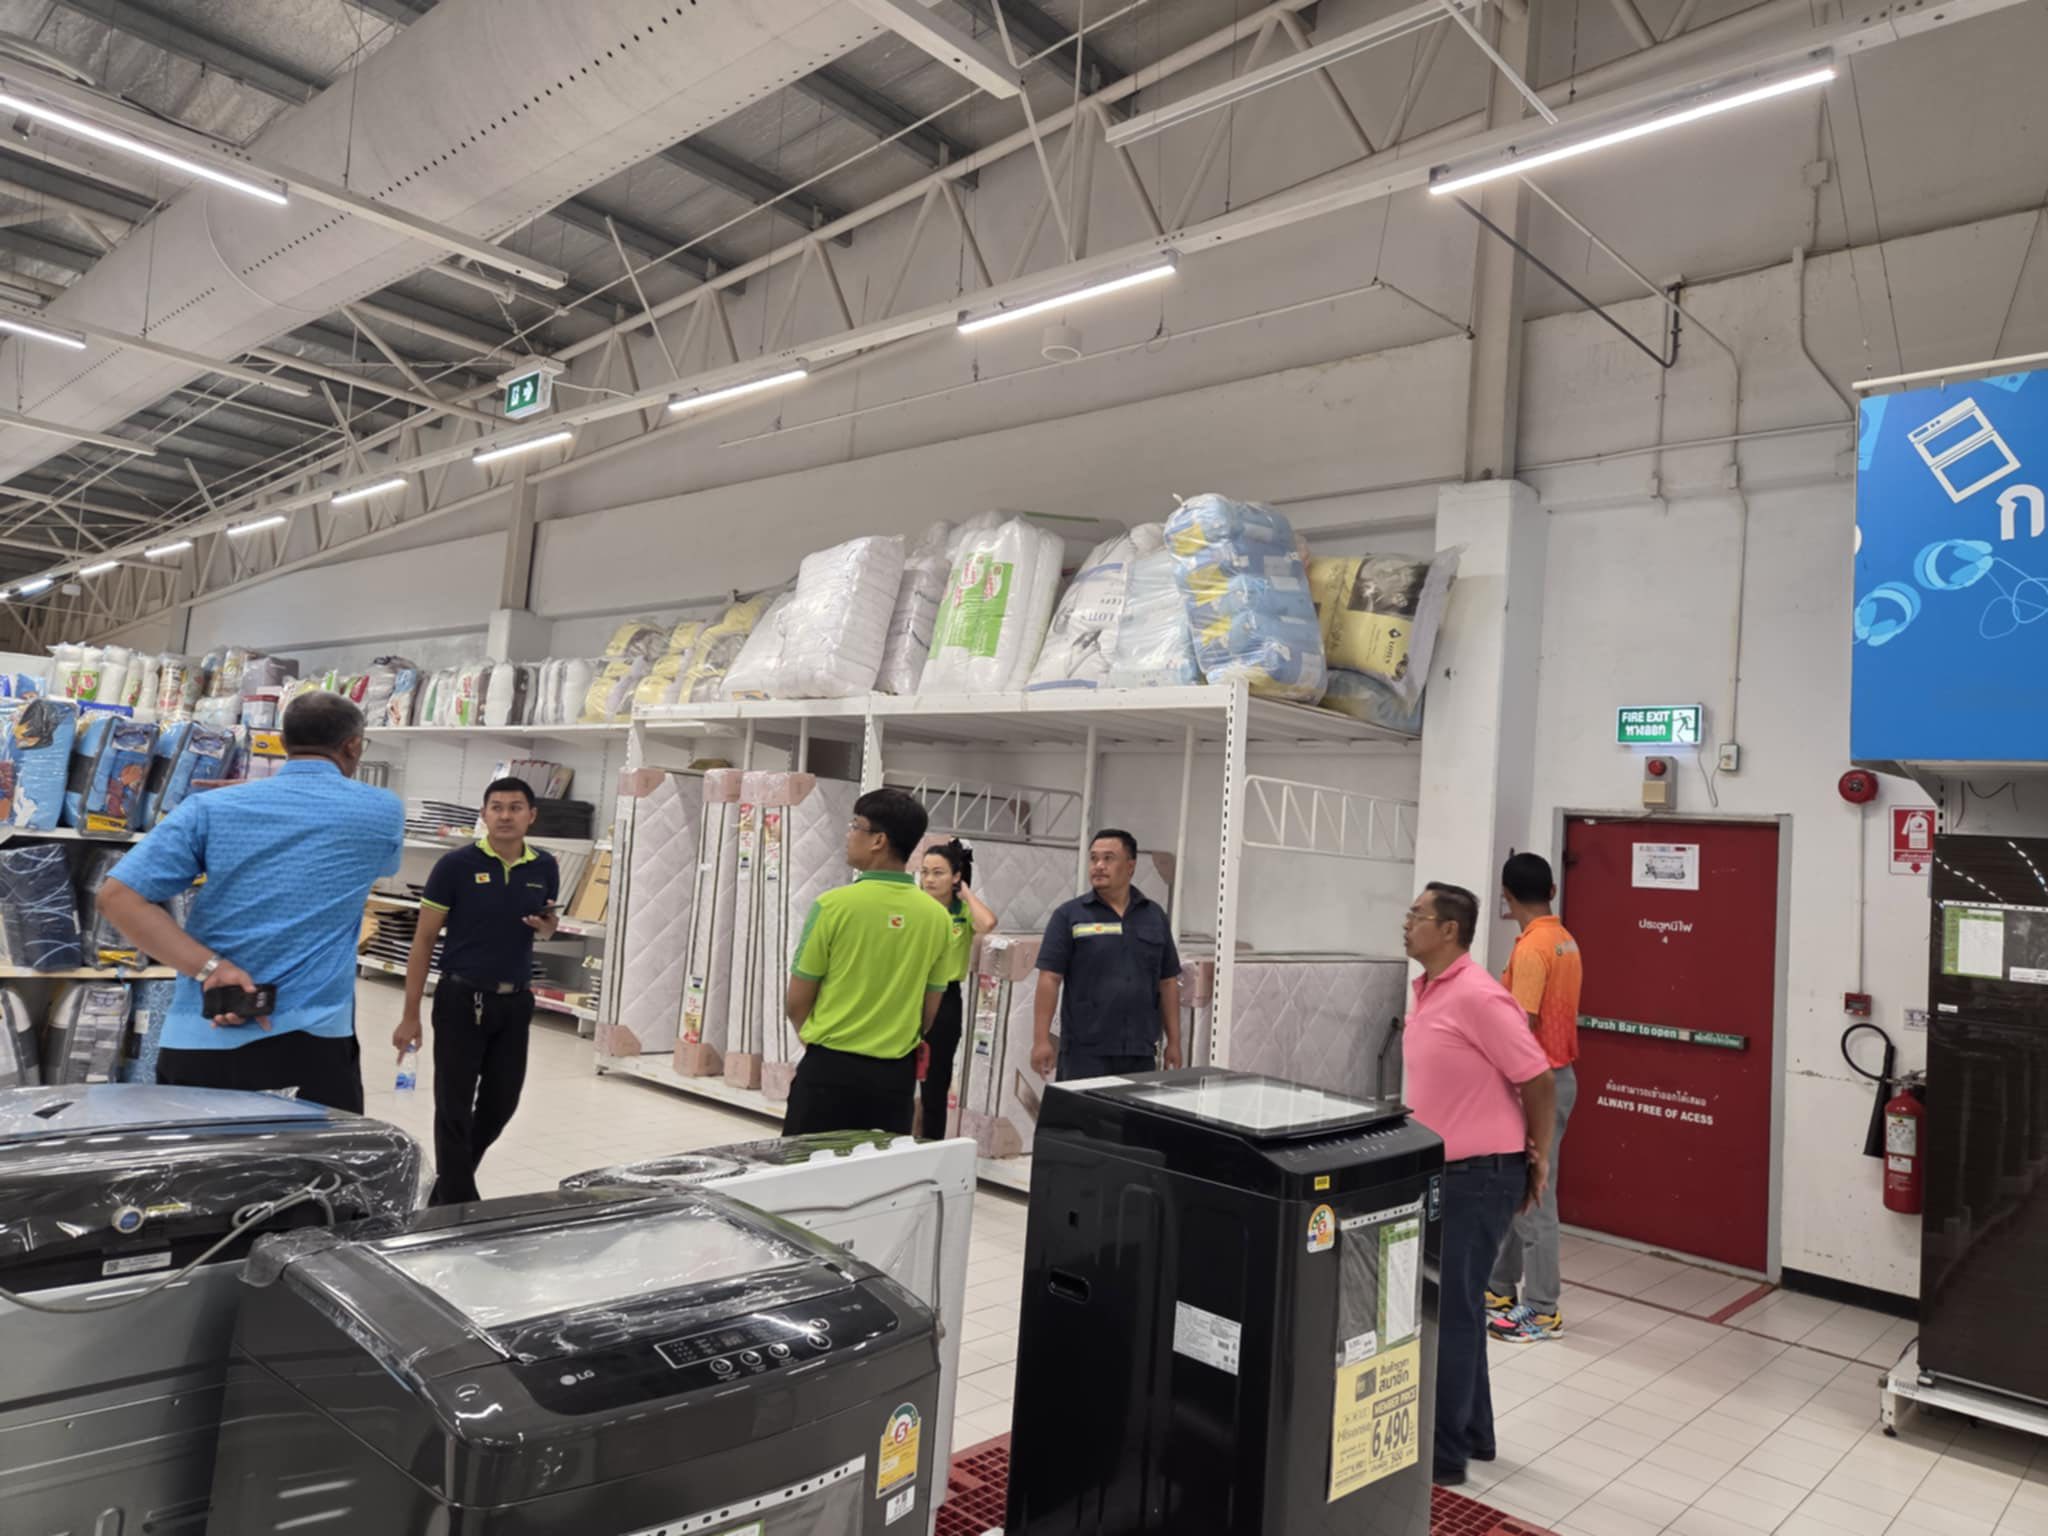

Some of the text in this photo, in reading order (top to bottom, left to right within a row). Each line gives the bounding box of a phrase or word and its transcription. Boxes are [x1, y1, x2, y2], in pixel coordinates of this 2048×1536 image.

[1622, 711, 1671, 723] FIRE EXIT
[1625, 724, 1666, 737] ทางออก
[1638, 917, 1693, 933] ประตูหนีไฟ
[1661, 935, 1668, 945] 4
[1618, 1021, 1636, 1034] Bar
[1639, 1023, 1650, 1035] to
[1651, 1027, 1677, 1039] open
[1597, 1096, 1714, 1126] ALWAYS FREE OF ACESS
[576, 1369, 595, 1381] LG
[1372, 1407, 1409, 1460] 6,490
